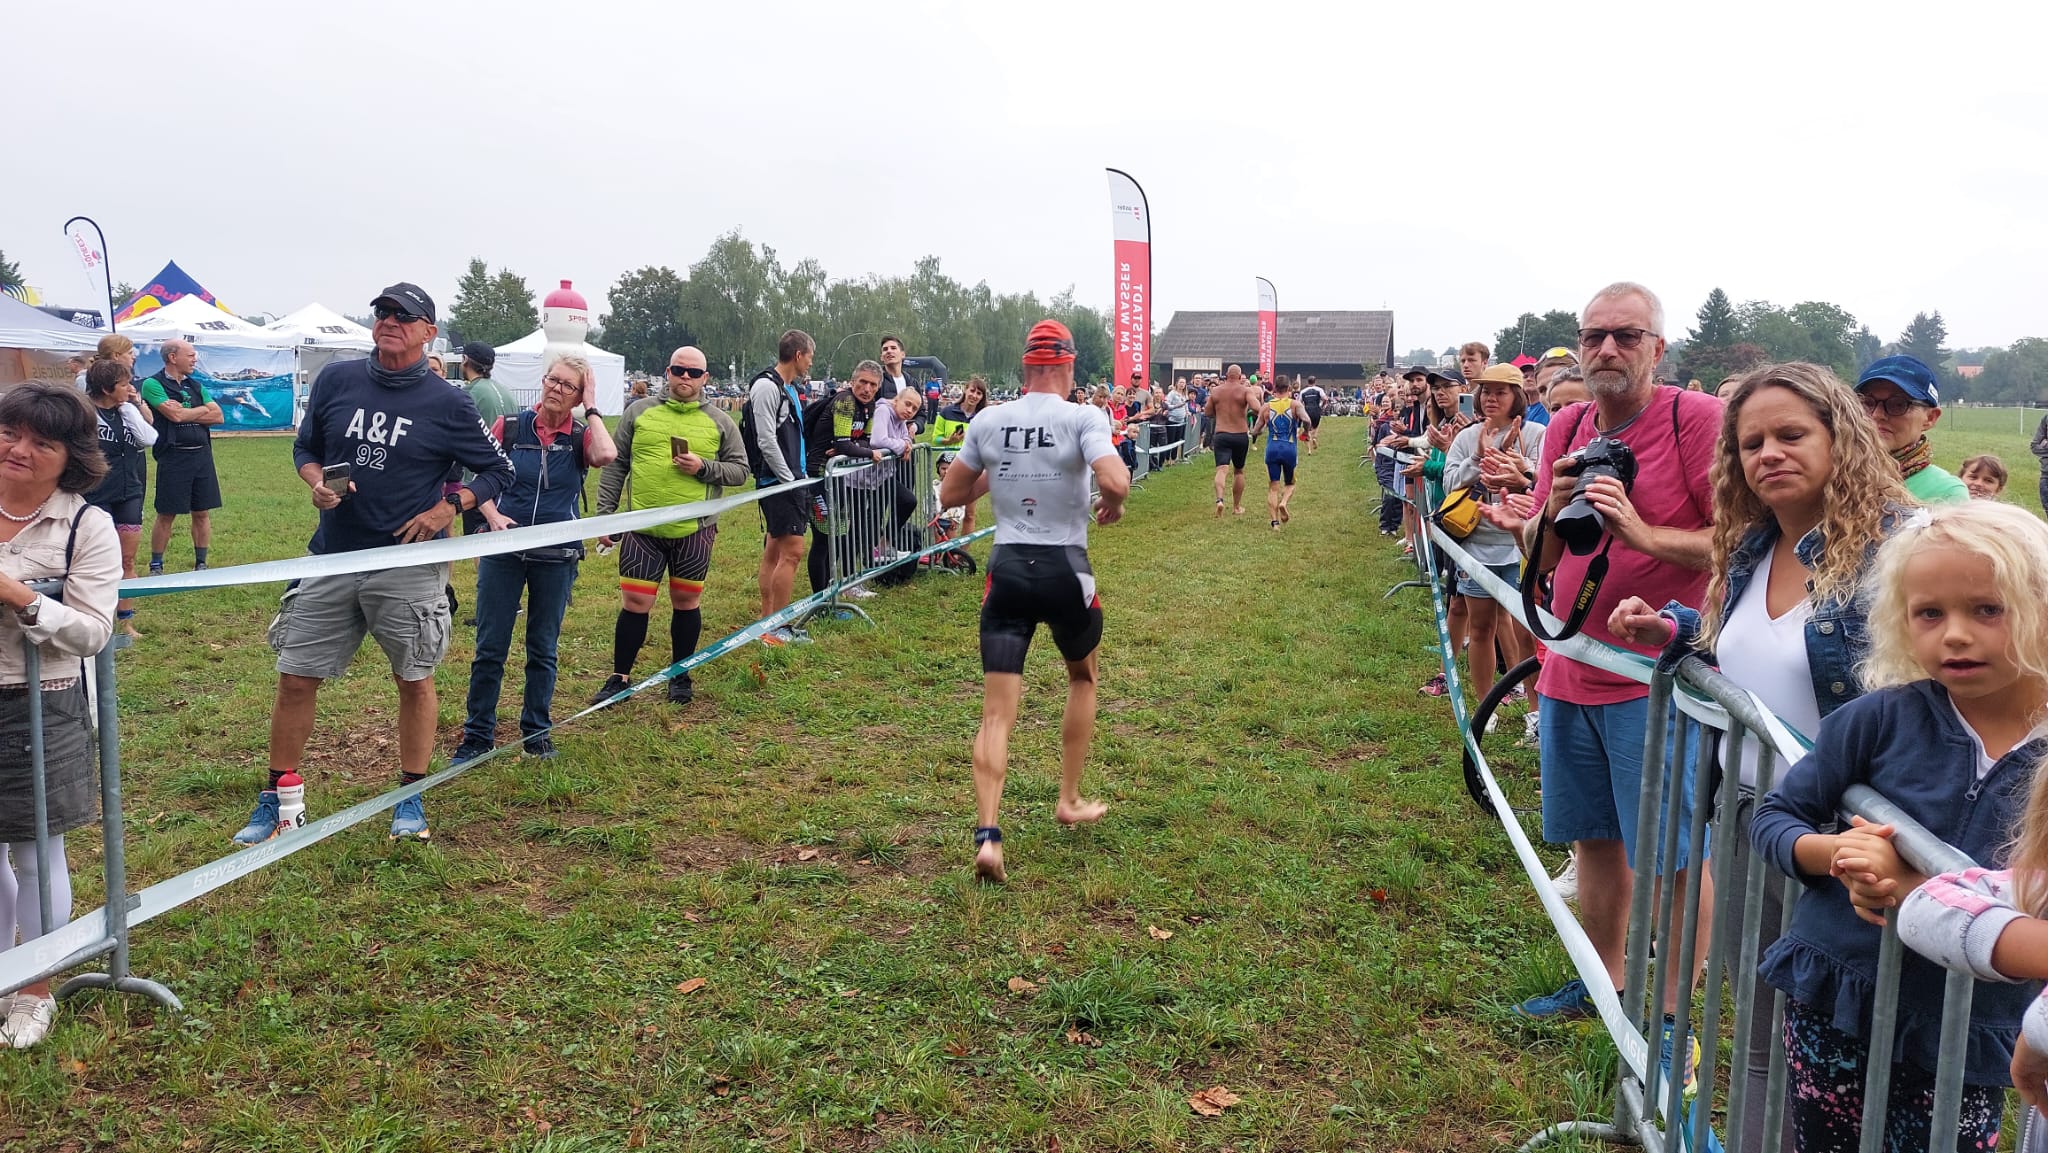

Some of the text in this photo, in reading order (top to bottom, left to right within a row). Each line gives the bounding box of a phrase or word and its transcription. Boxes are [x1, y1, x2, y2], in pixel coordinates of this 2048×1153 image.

[344, 408, 413, 447] A&F
[355, 443, 387, 471] 92
[1577, 579, 1596, 611] Nikon
